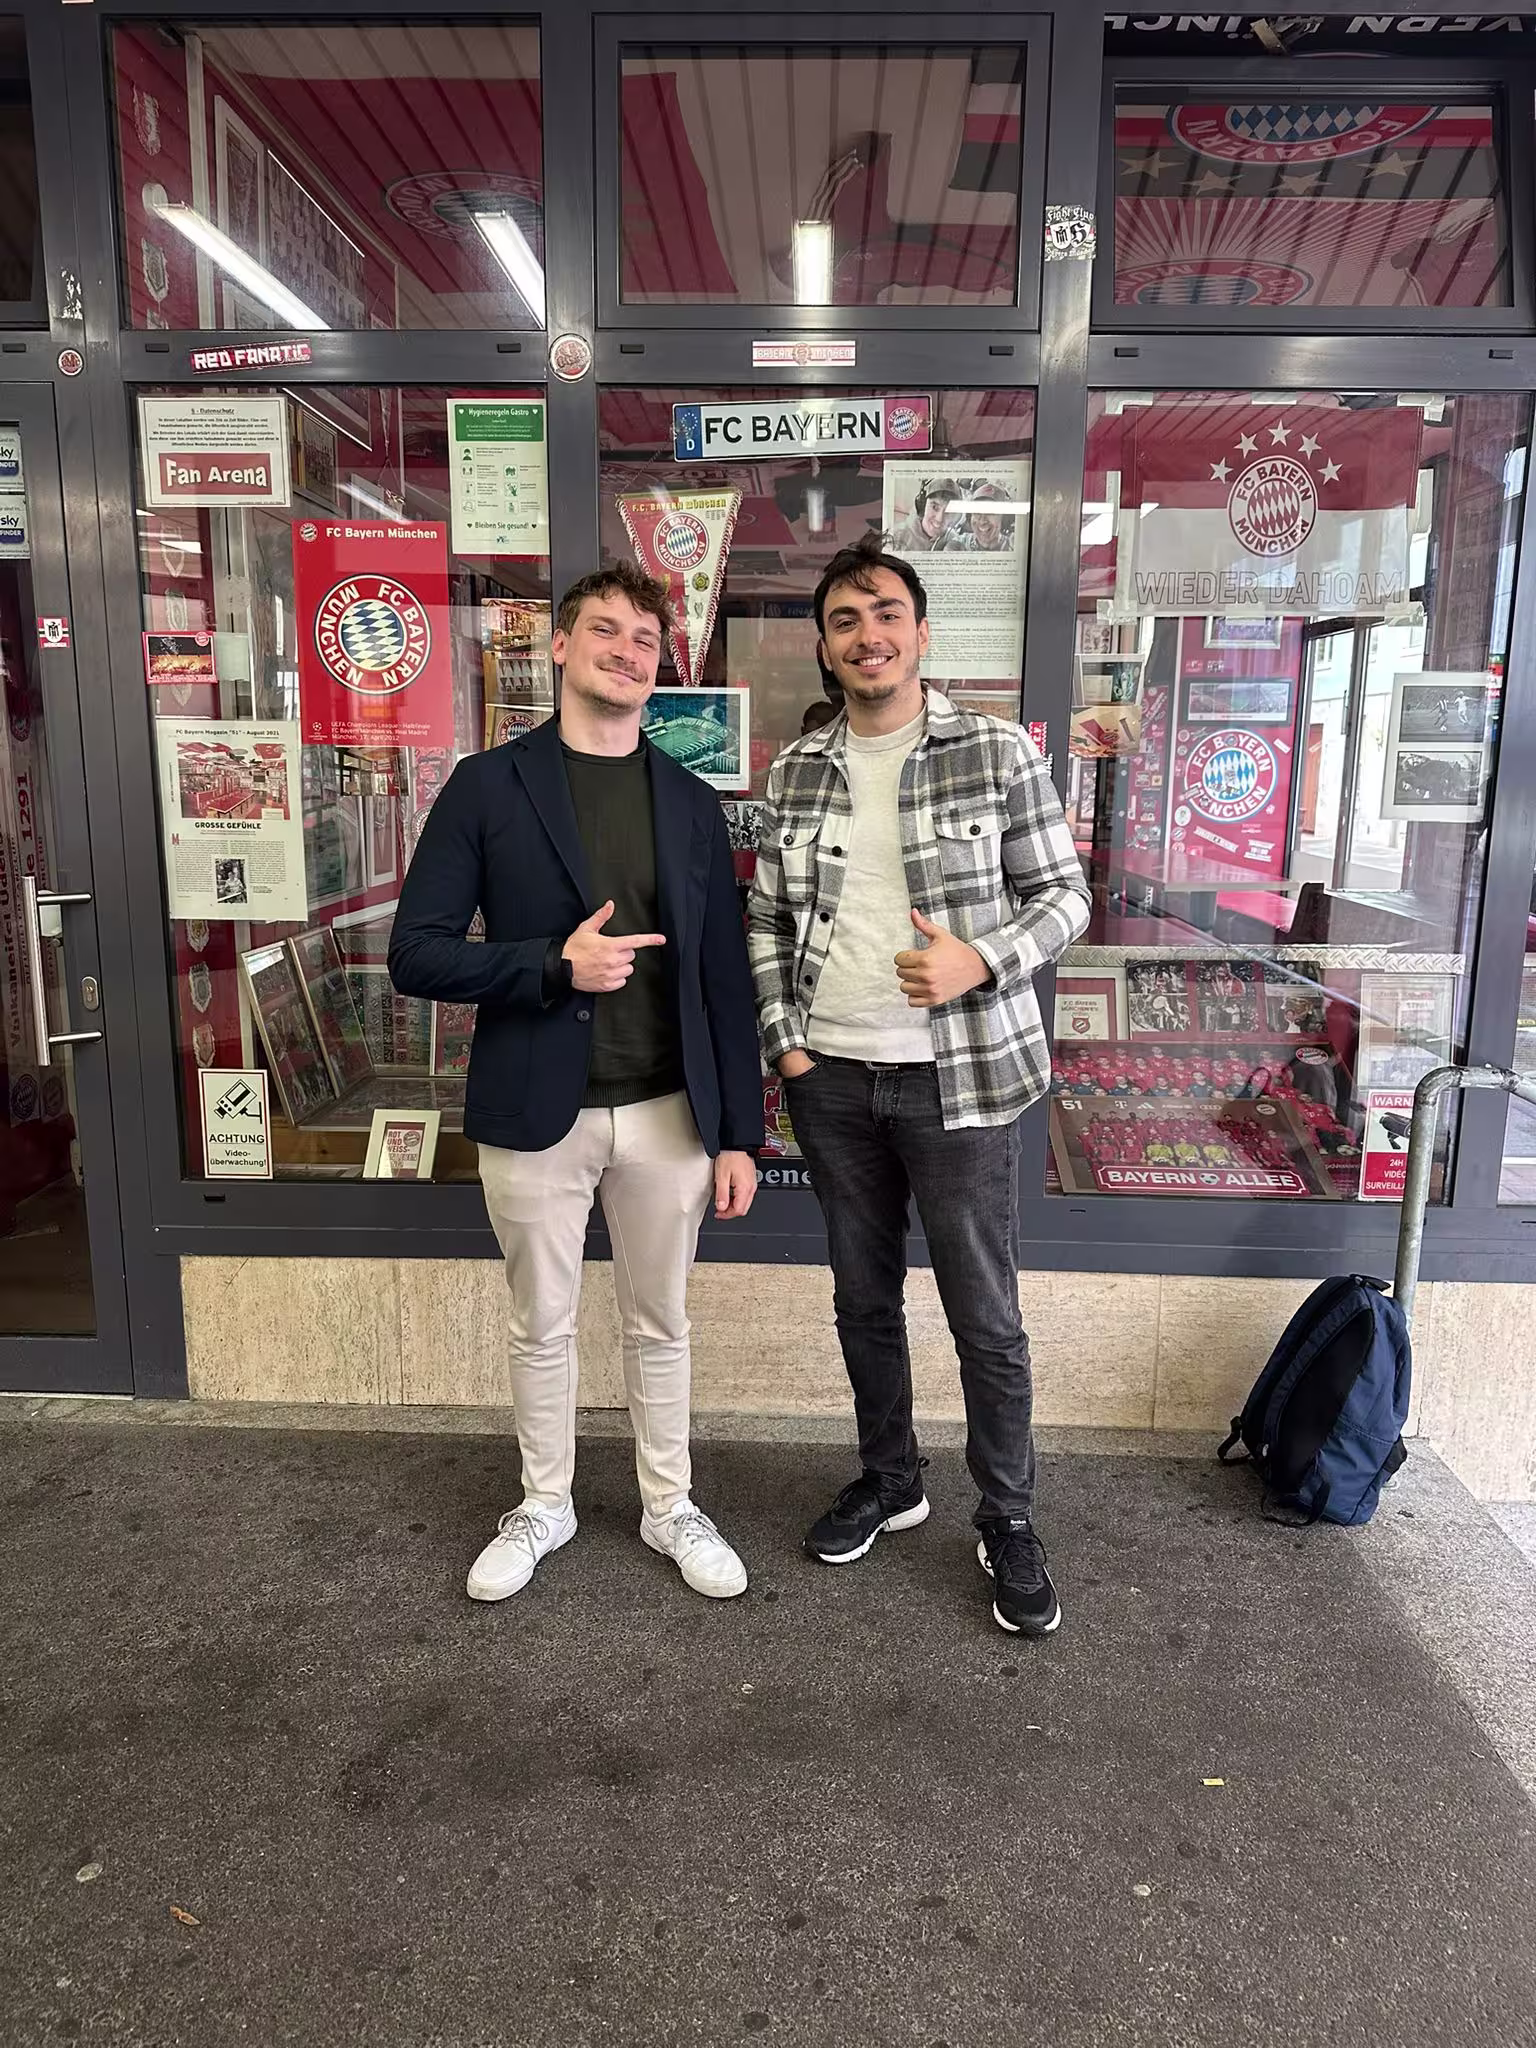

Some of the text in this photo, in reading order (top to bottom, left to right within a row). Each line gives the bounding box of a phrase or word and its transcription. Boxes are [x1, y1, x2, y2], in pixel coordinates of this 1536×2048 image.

[1185, 119, 1339, 160] BAYERN
[468, 408, 529, 417] Hygieneregeln Gastro
[704, 411, 881, 444] FC BAYERN
[686, 438, 695, 451] D
[0, 446, 14, 459] ky
[166, 458, 268, 487] Fan Arena
[1236, 463, 1312, 502] FC BAYERN
[650, 501, 684, 511] BAYERN
[685, 499, 728, 510] MÜNCHEN
[0, 514, 20, 528] sky
[659, 516, 703, 538] FC BAYERN
[326, 527, 342, 538] FC
[345, 527, 385, 540] Bayern
[387, 527, 437, 539] München
[1235, 517, 1310, 553] MÜNCHEN
[1134, 570, 1402, 606] WIEDER DAHOAM
[377, 582, 426, 687] FC BAYERN
[347, 721, 377, 729] Champions
[408, 728, 428, 736] Madrid
[1193, 733, 1272, 773] FC BYERN
[17, 771, 34, 842] 1291
[194, 820, 262, 829] GROSSE GEFÜHLE
[1061, 1099, 1083, 1111] 51
[1374, 1096, 1413, 1107] WARN
[209, 1133, 265, 1144] ACHTUNG
[224, 1149, 251, 1157] Video-
[210, 1158, 267, 1168] überwachung!
[1389, 1159, 1404, 1167] 24H
[1107, 1170, 1298, 1188] BAYERN ALLEE
